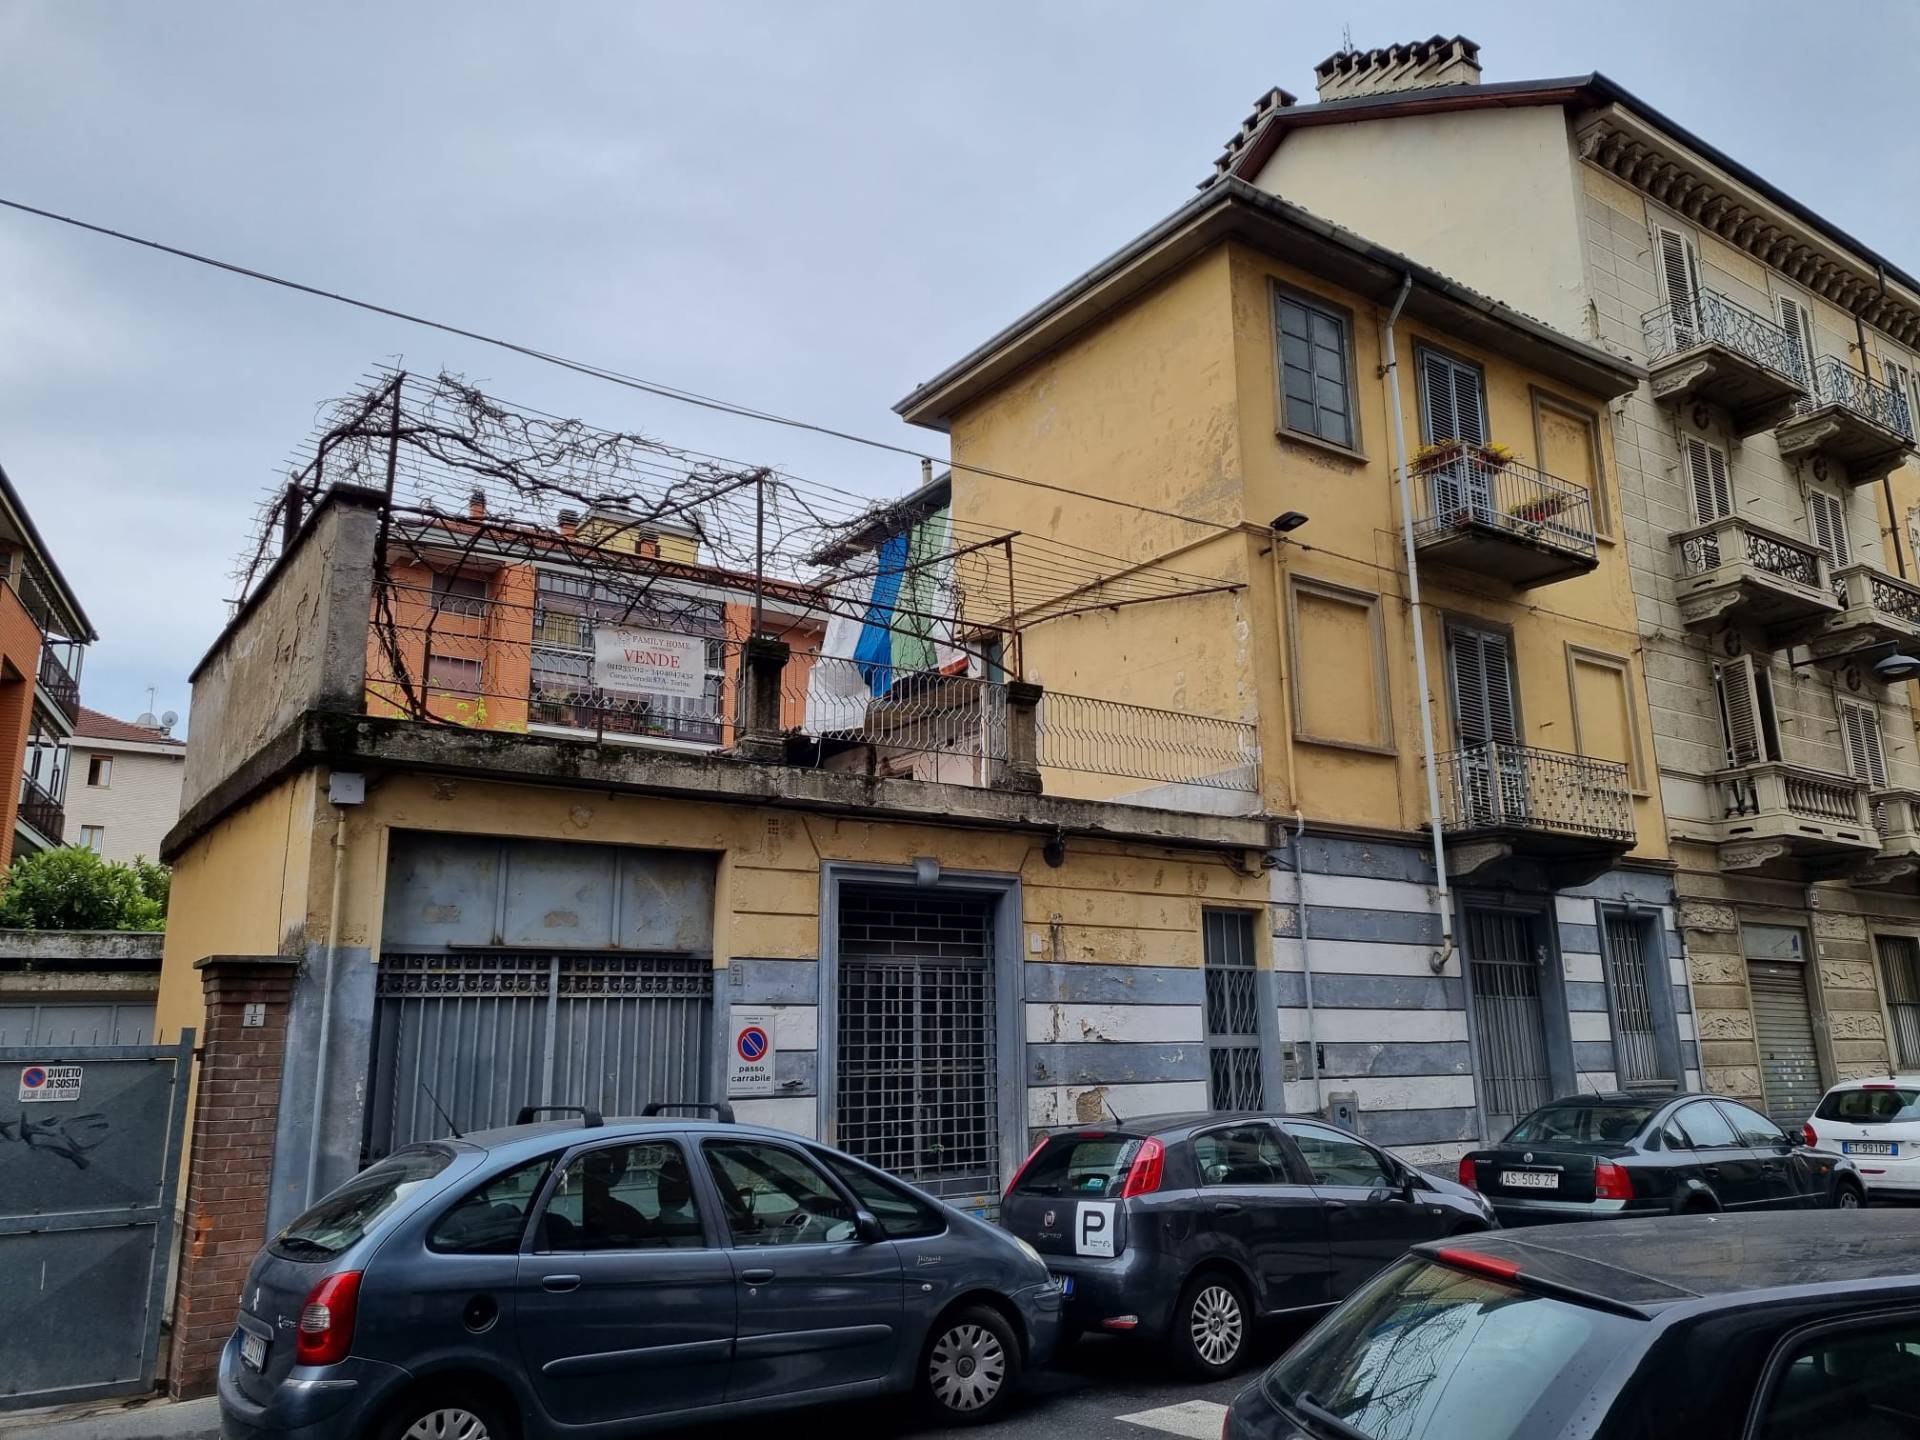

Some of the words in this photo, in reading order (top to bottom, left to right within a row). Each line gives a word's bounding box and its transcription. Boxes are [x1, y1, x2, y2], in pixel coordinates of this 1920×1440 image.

[632, 635, 664, 646] FAMILY
[666, 640, 690, 649] HOME
[624, 649, 680, 668] VENDE
[251, 1015, 258, 1025] E
[48, 1068, 81, 1078] DIVIETO
[731, 1074, 771, 1082] carrabile
[46, 1079, 54, 1089] DI
[55, 1079, 80, 1089] SOSTA
[1848, 1143, 1860, 1153] ET
[1505, 1173, 1517, 1184] AS
[1522, 1173, 1540, 1186] 503
[1083, 1210, 1106, 1246] P
